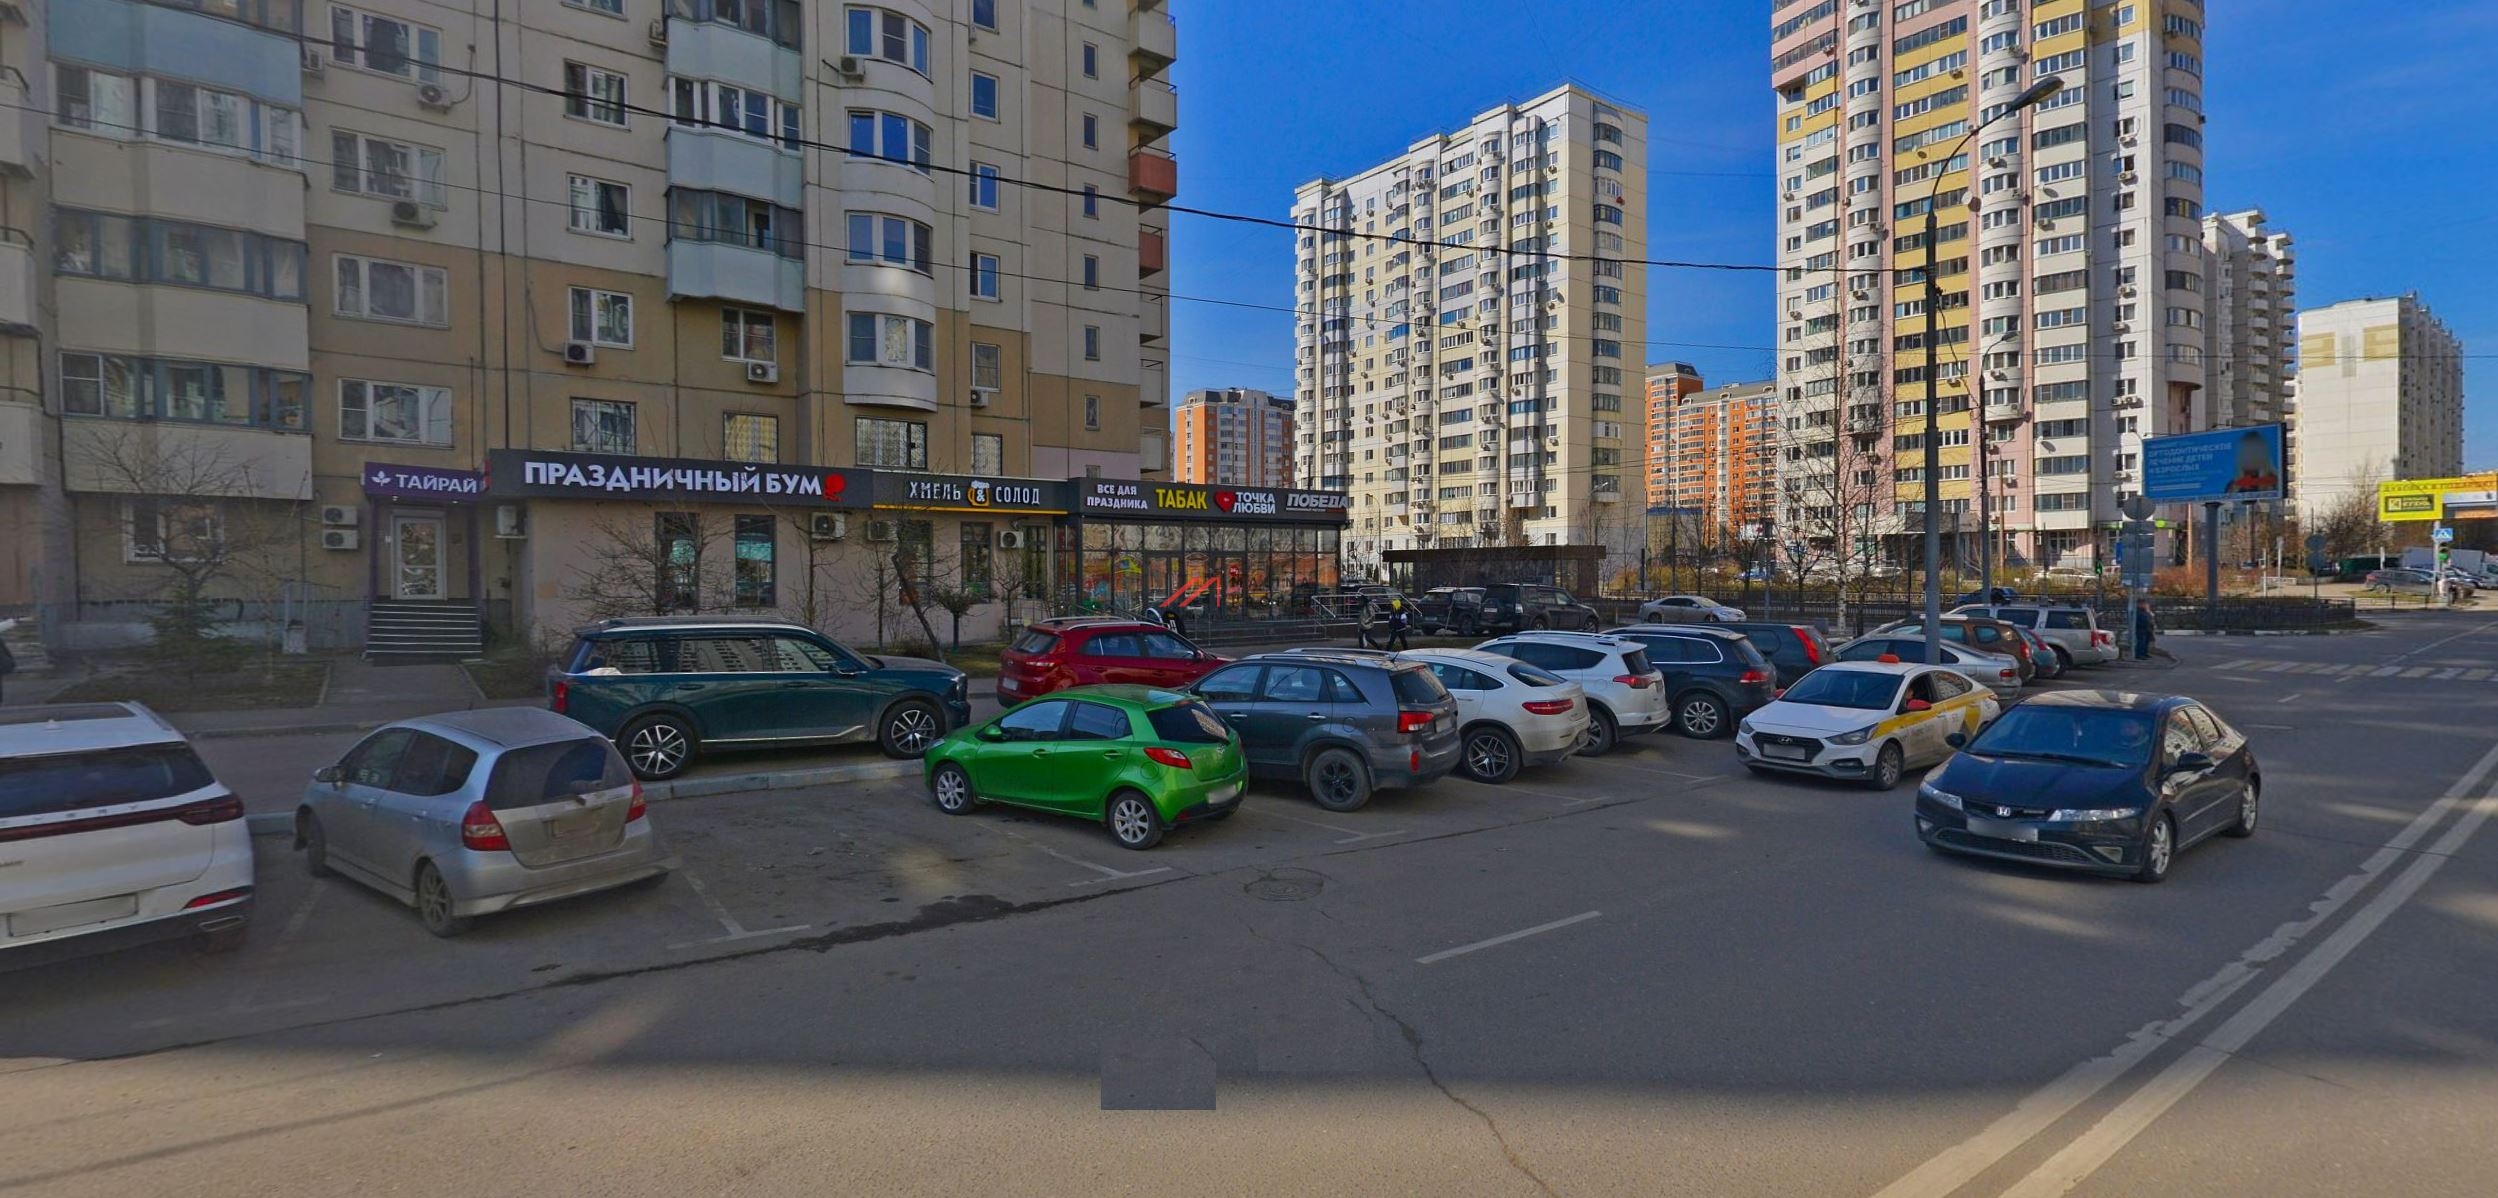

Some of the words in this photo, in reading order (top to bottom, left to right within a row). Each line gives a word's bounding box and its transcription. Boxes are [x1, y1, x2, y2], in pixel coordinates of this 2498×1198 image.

[395, 473, 478, 494] ТАЙРАЙ
[524, 461, 760, 494] ПРАЗДНИЧНЫЙ
[766, 473, 822, 495] БУМ
[909, 481, 961, 500] ХМЕЛЬ
[976, 489, 985, 502] &
[995, 486, 1040, 505] СОЛОД
[1097, 484, 1115, 494] ВСЕ
[1117, 485, 1137, 496] ДЛЯ
[1235, 491, 1276, 503] ТОЧКА
[1086, 496, 1148, 510] ПРАЗДНИКА
[1155, 488, 1208, 510] ТАБАК
[1286, 493, 1349, 508] ПОБЕДА
[1232, 502, 1276, 514] ЛЮБВИ
